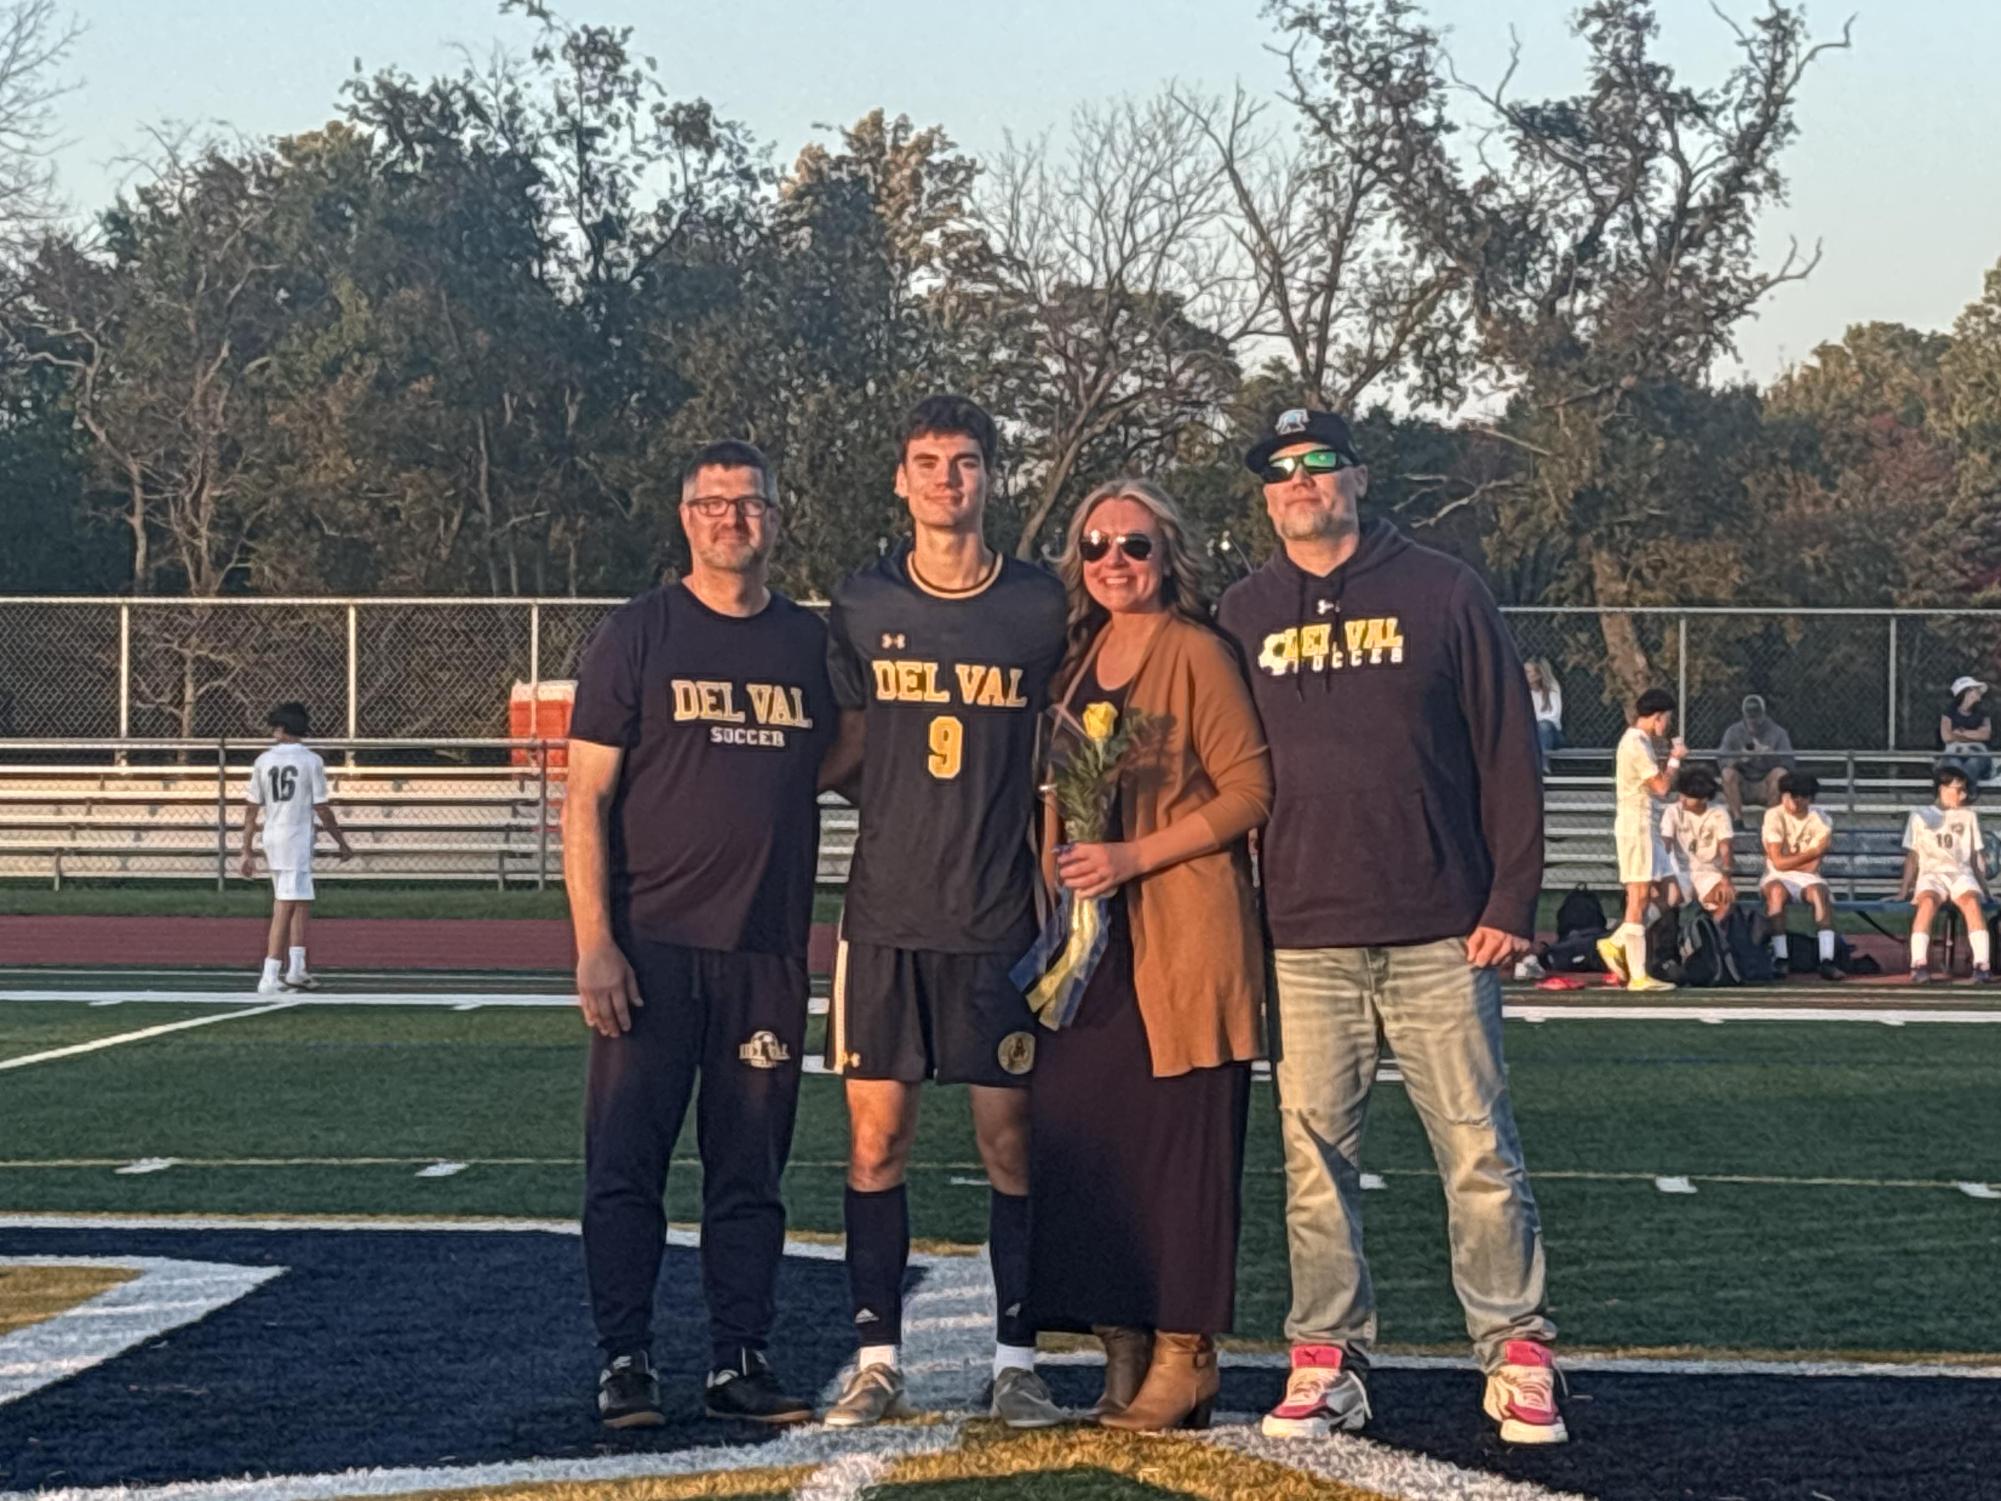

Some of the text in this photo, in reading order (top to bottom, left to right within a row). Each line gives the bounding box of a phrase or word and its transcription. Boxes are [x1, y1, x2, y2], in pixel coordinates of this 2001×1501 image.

[1345, 617, 1404, 651] VAL
[872, 660, 1029, 707] DEL VAL
[671, 679, 813, 729] DEL VAL
[710, 726, 785, 747] SOCCER
[928, 715, 963, 779] 9
[268, 765, 298, 803] 16
[1936, 832, 1954, 850] 10
